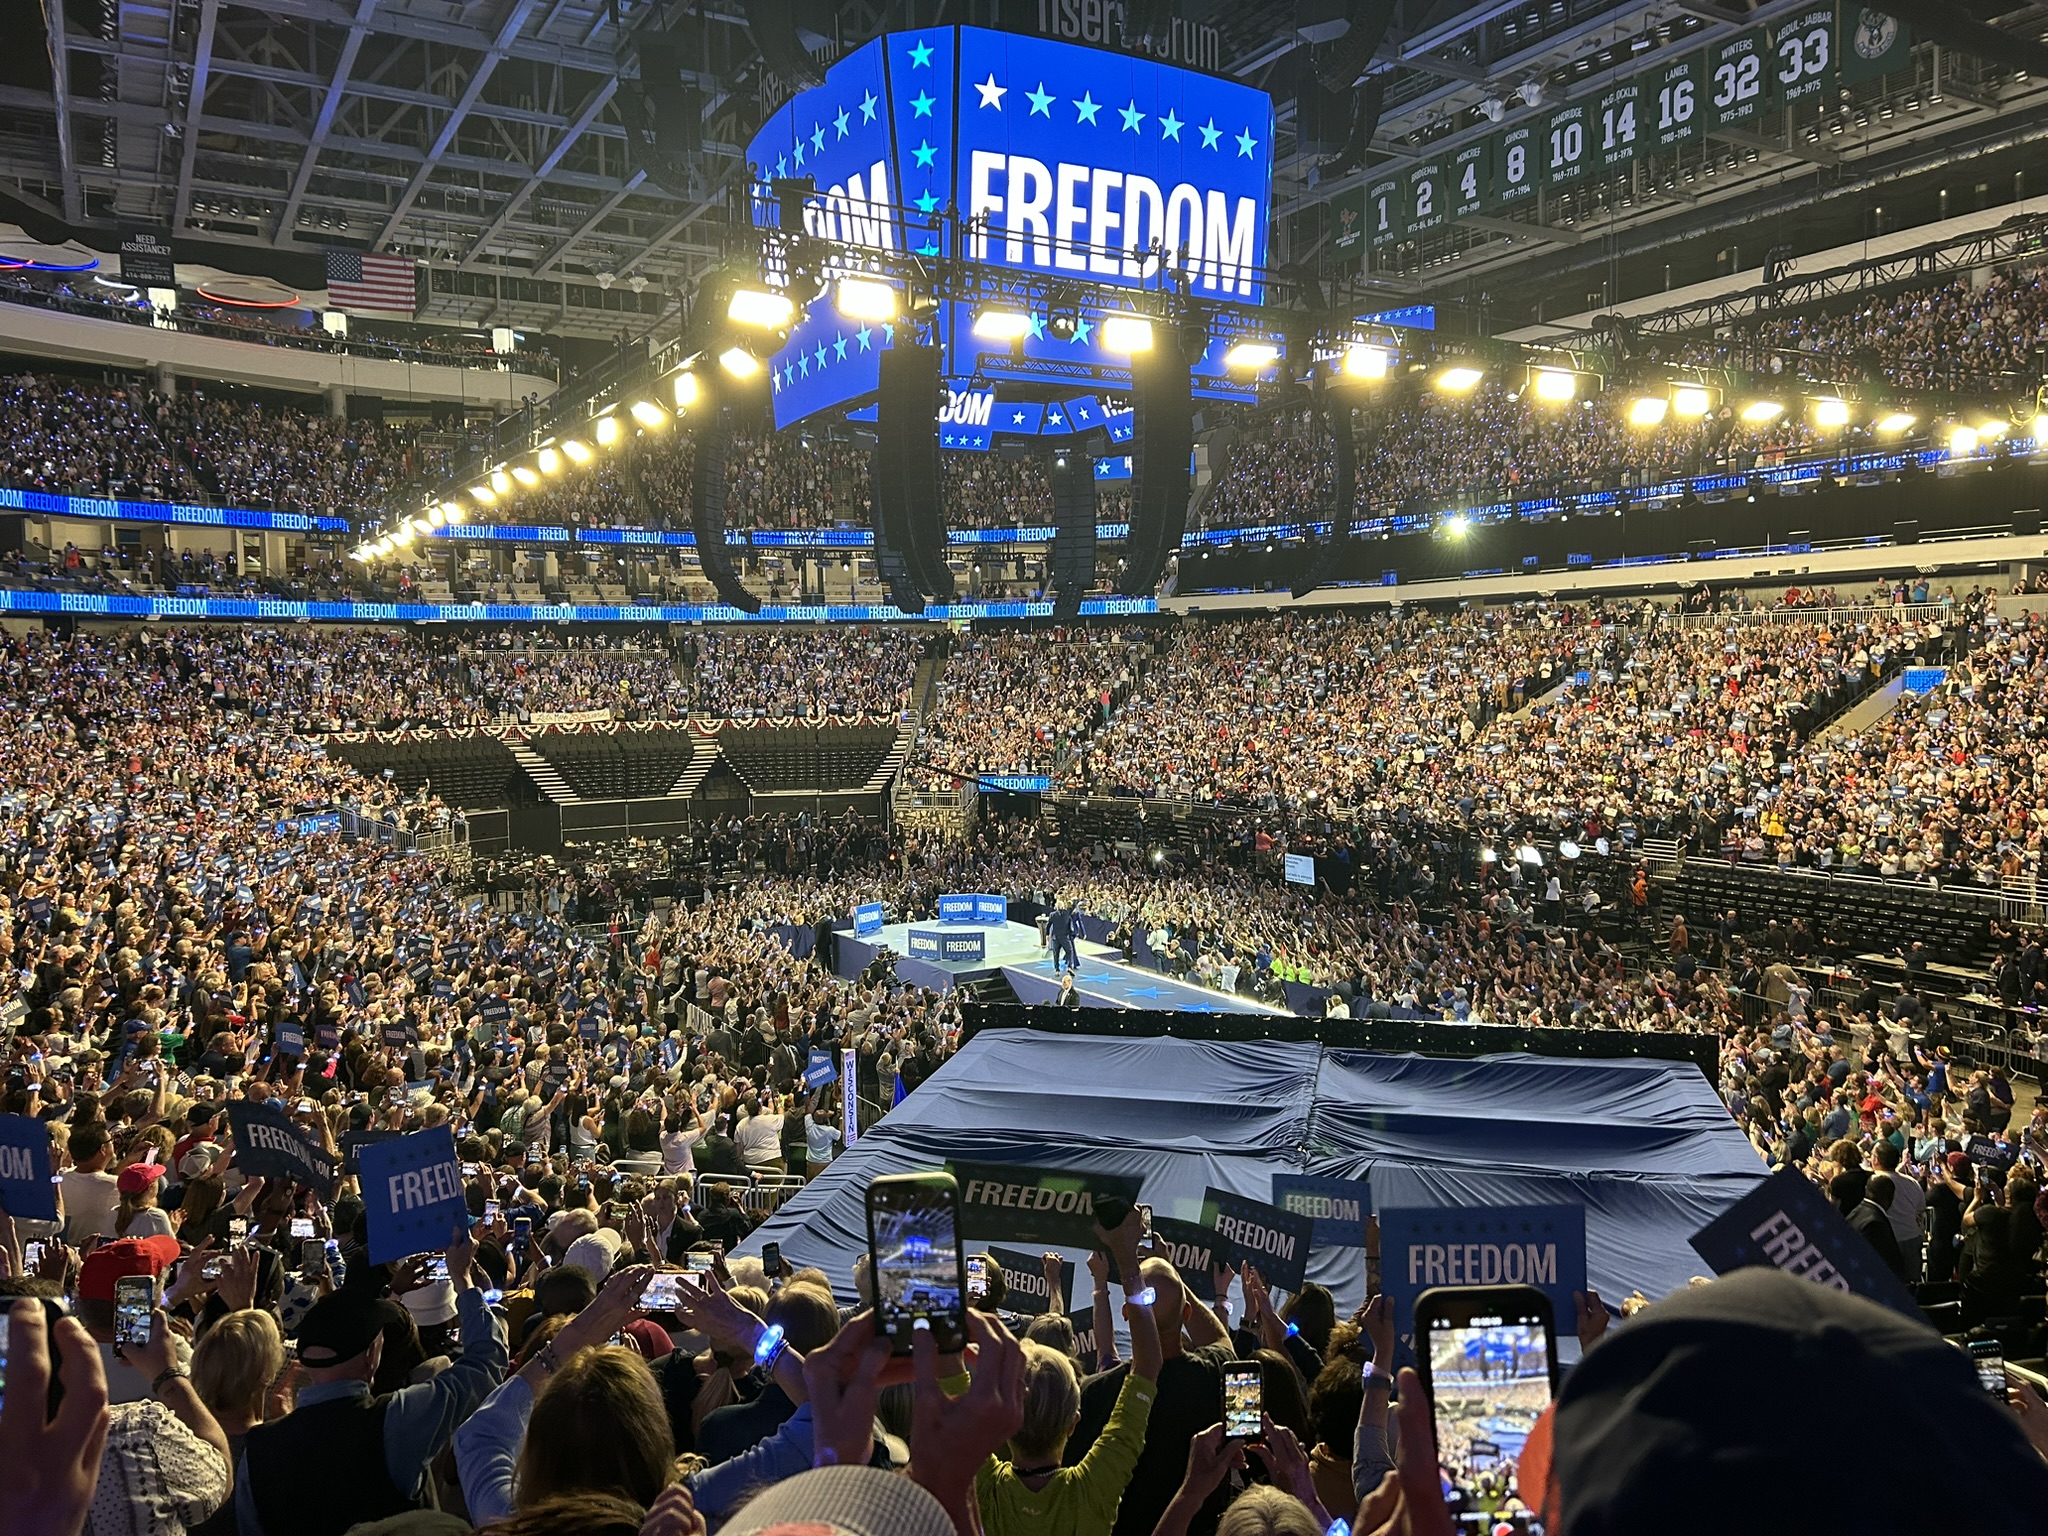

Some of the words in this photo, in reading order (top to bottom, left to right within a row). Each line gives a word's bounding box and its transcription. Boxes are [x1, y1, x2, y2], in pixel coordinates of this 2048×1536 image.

[1776, 11, 1833, 43] ABDUL-JABBAR
[1721, 38, 1753, 60] WINTERS
[1779, 28, 1829, 84] 33
[1665, 64, 1689, 82] LANIER
[1714, 54, 1760, 107] 32
[1785, 79, 1822, 101] 1969-1975
[1658, 79, 1695, 130] 16
[1719, 103, 1753, 124] 1975-1983
[1551, 107, 1582, 128] DANDRIDGE
[1602, 101, 1636, 150] 14
[1504, 128, 1529, 146] JOHNSON
[1550, 122, 1583, 169] 10
[1660, 126, 1692, 145] 1980-1984
[1457, 147, 1481, 165] MONCRIEF
[1507, 145, 1525, 184] 8
[1411, 166, 1438, 183] BRIDGEMAN
[1461, 162, 1476, 200] 4
[1371, 182, 1396, 199] ROBERTSON
[1416, 181, 1432, 217] 2
[1502, 184, 1530, 200] 1977-1984
[970, 150, 1256, 296] FREEDOM
[1378, 197, 1388, 231] 1
[121, 242, 171, 255] ASSISTANCE?
[135, 234, 156, 244] NEED
[22, 492, 69, 512] FREEDOM
[68, 497, 119, 517] FREEDOM
[118, 501, 172, 520] FREEDOM
[172, 506, 223, 524] FREEDOM
[223, 509, 272, 528] FREEDOM
[450, 525, 494, 538] FREEDOM
[1017, 528, 1056, 541] FREEDOM
[12, 592, 61, 611] FREEDOM
[61, 593, 108, 612] FREEDOM
[108, 595, 152, 614] FREEDOM
[152, 598, 207, 614] FREEDOM
[207, 600, 259, 617] FREEDOM
[258, 601, 308, 617] FREEDOM
[307, 602, 352, 618] FREEDOM
[352, 602, 397, 618] FREEDOM
[397, 602, 440, 620] FREEDOM
[439, 605, 487, 619] FREEDOM
[486, 605, 533, 620] FREEDOM
[532, 605, 577, 620] FREEDOM
[577, 605, 620, 620] FREEDOM
[619, 606, 662, 620] FREEDOM
[661, 606, 703, 620] FREEDOM
[702, 606, 745, 620] FREEDOM
[786, 606, 828, 620] FREEDOM
[828, 606, 869, 620] FREEDOM
[868, 606, 902, 620] FREEDO
[948, 604, 987, 617] FREEDOM
[987, 603, 1026, 617] FREEDOM
[1105, 600, 1147, 614] FREEDOM
[858, 911, 879, 923] FREEDOM
[944, 902, 973, 912] FREEDOM
[978, 902, 1003, 913] FREEDOM
[911, 938, 938, 951] FREEDOM
[947, 940, 981, 952] FREEDOM
[411, 963, 429, 977] FREEDOM
[483, 1006, 507, 1016] FREEDOM
[807, 1065, 831, 1081] FREEDOM
[846, 1060, 854, 1133] WISCONSIN
[246, 1123, 315, 1174] FREEDOM
[1286, 1194, 1360, 1222] FREEDOM
[1215, 1213, 1296, 1261] FREEDOM
[1408, 1243, 1557, 1285] FREEDOM
